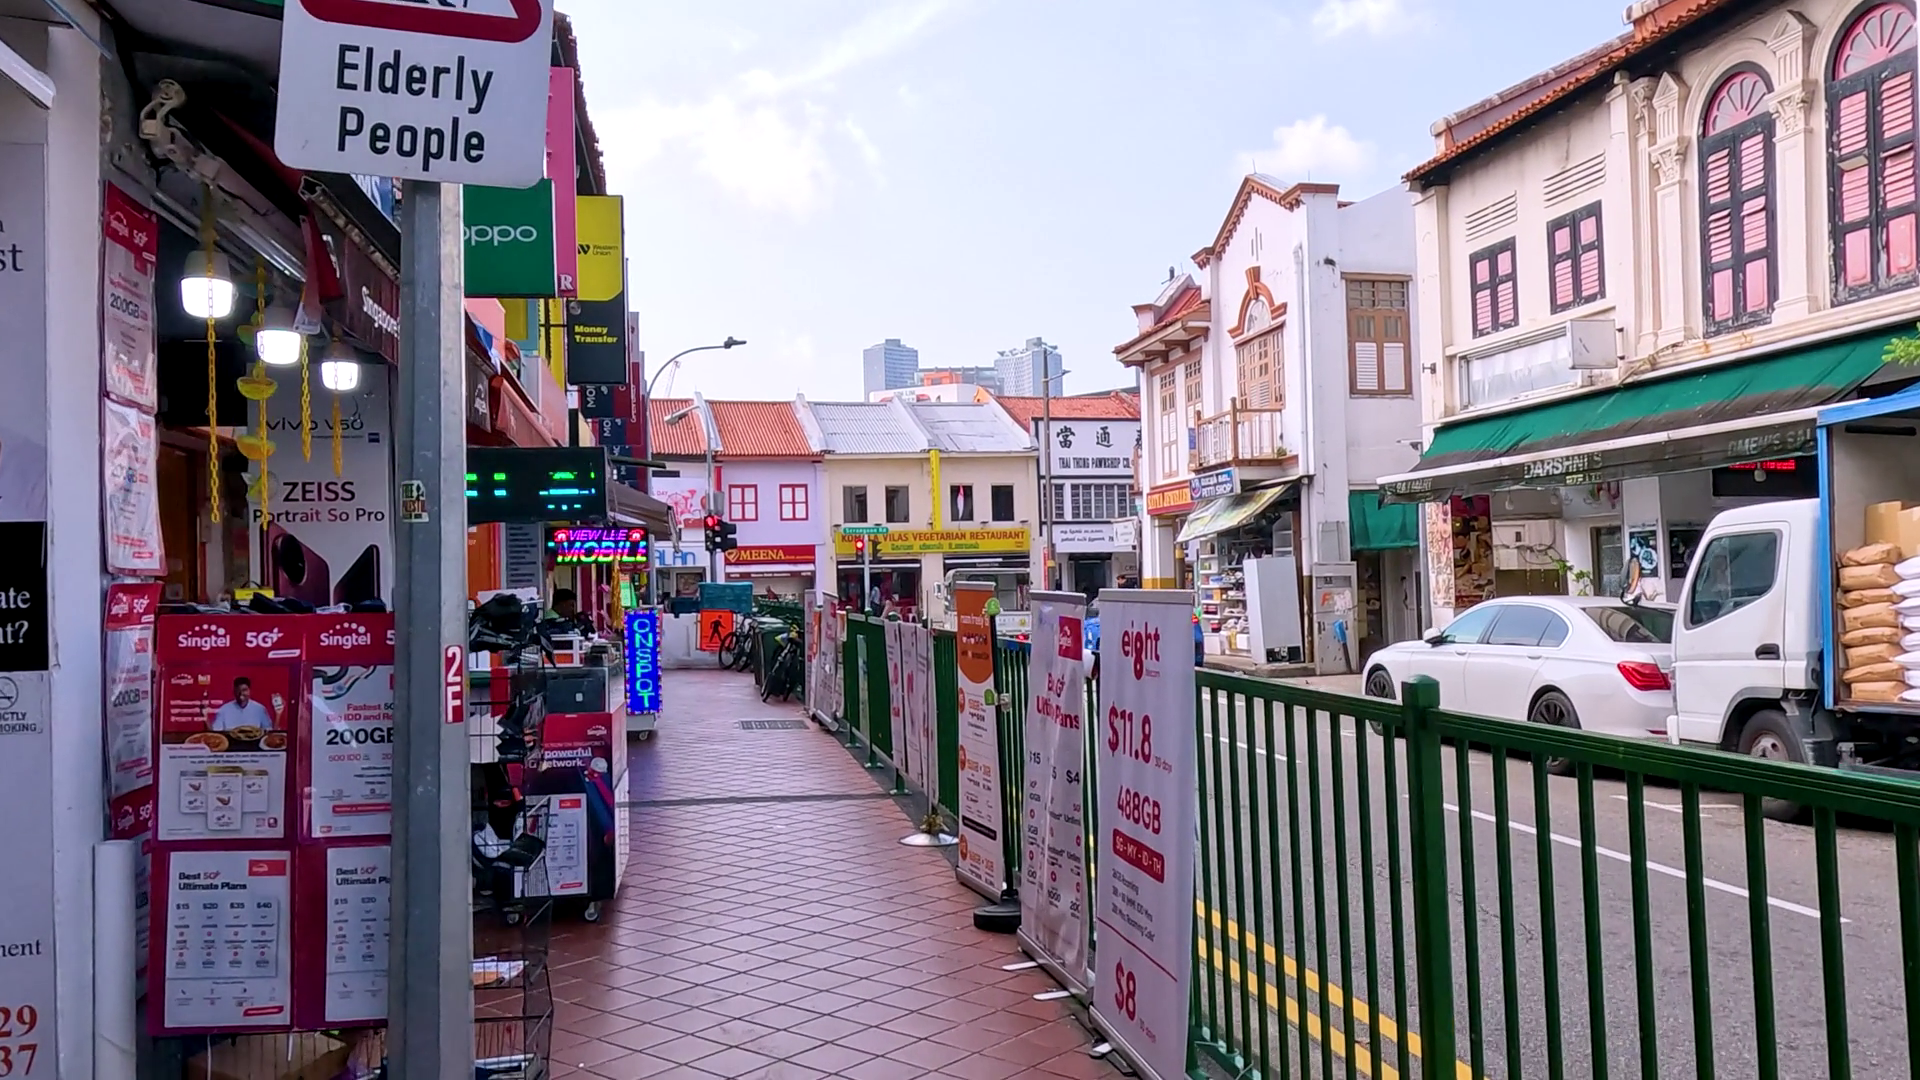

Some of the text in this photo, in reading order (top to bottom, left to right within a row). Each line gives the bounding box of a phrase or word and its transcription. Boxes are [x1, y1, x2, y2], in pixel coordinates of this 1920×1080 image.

[336, 43, 495, 115] Elderly
[337, 105, 486, 172] People
[109, 293, 141, 319] 200GB
[574, 324, 608, 335] Money
[574, 334, 618, 344] Transfer
[1058, 457, 1071, 469] THAI
[283, 481, 356, 502] ZEISS
[253, 508, 385, 523] Portrait So Pro
[569, 529, 629, 541] VIEW LEE
[882, 532, 909, 542] VILAS
[912, 532, 966, 541] VEGETARIAN
[969, 531, 1025, 540] RESTAURANT
[556, 541, 647, 563] MOBILE
[739, 549, 785, 560] MEENA
[178, 631, 231, 651] Singtel
[320, 631, 371, 649] Singtel
[452, 646, 466, 722] 2F
[347, 703, 382, 711] Fastest
[344, 713, 362, 721] IDD
[362, 712, 381, 721] and
[326, 727, 394, 745] 200GB
[1107, 700, 1152, 764] $11.8
[545, 746, 593, 760] powerful
[1117, 784, 1161, 835] 488GB
[1126, 842, 1138, 860] MY
[1152, 857, 1162, 874] TH
[178, 872, 201, 880] Best
[336, 867, 358, 876] Best
[178, 881, 248, 891] Ultimate Plans
[335, 876, 377, 885] Ultimate
[202, 902, 219, 910] $20
[256, 901, 273, 909] $40
[1114, 956, 1136, 1021] $8
